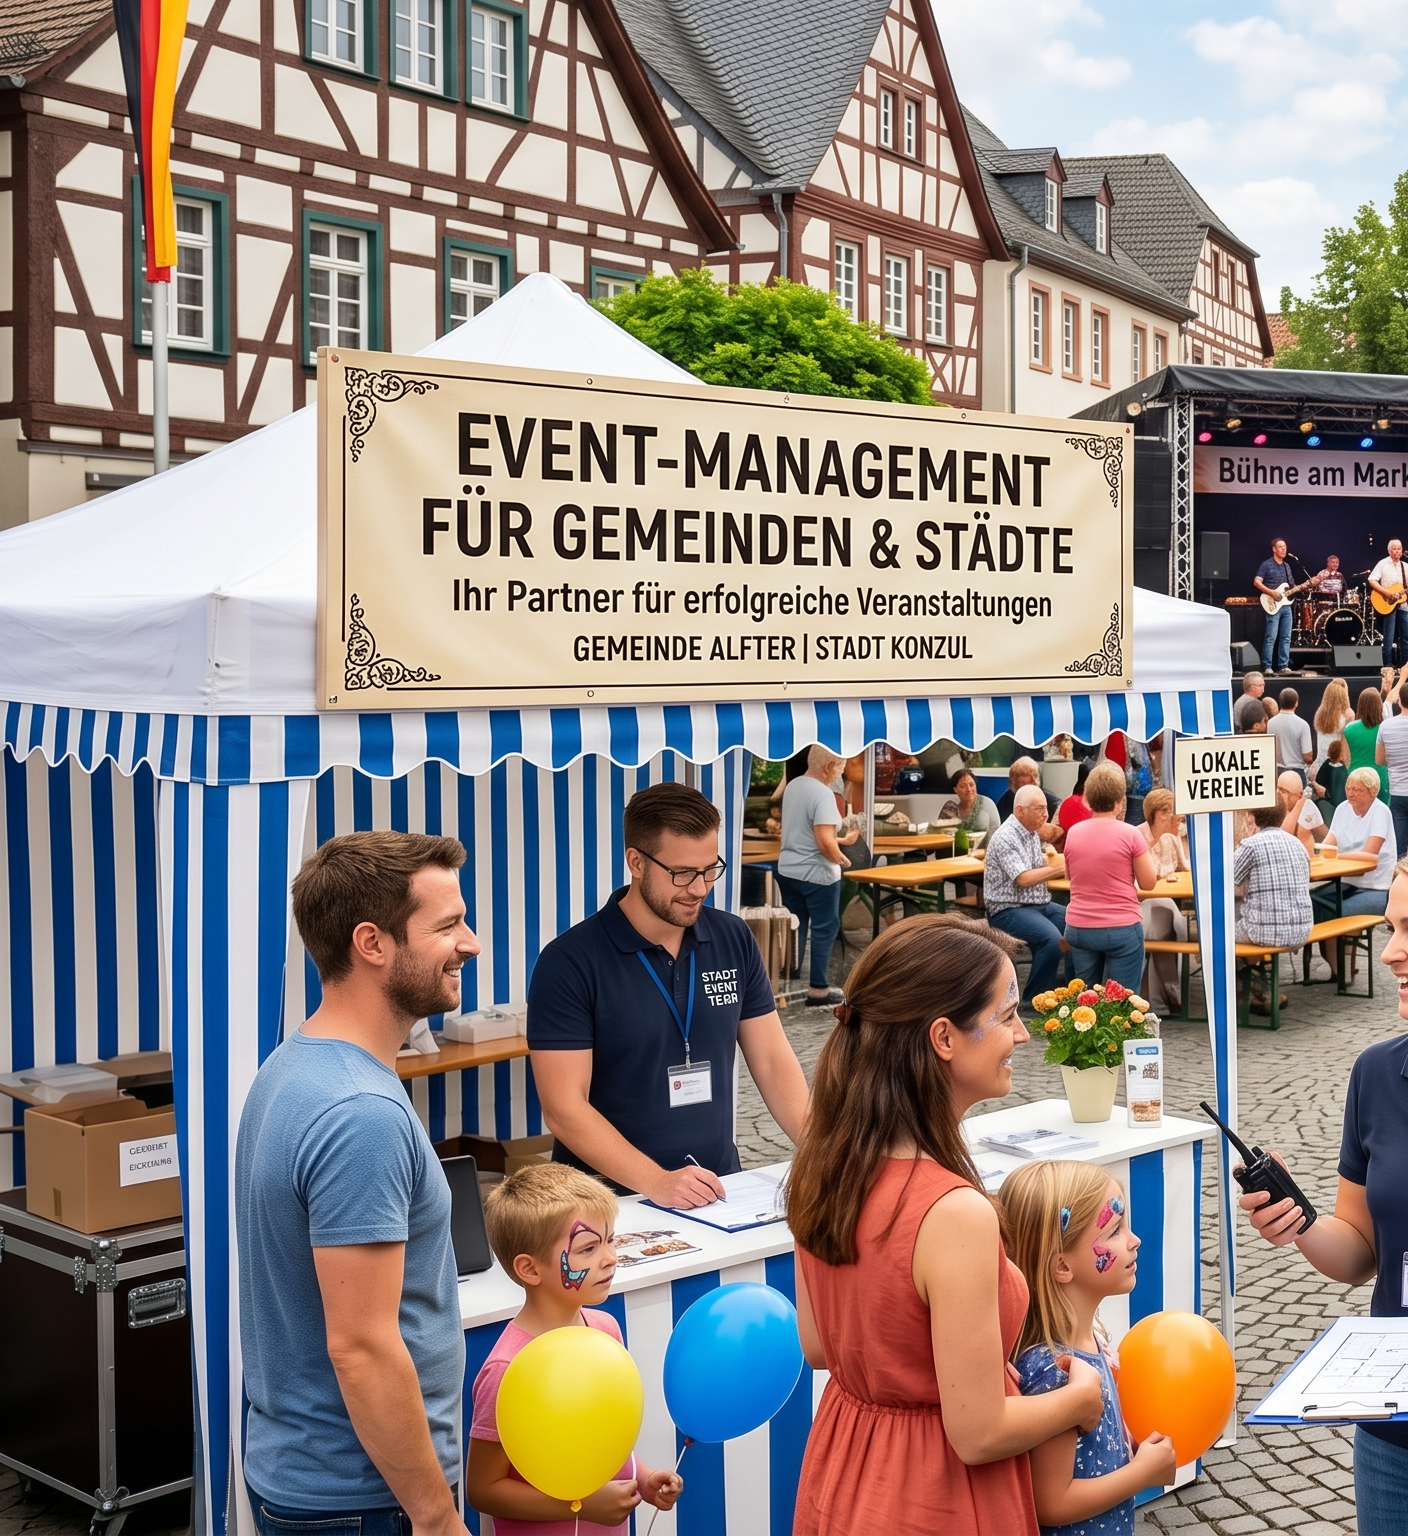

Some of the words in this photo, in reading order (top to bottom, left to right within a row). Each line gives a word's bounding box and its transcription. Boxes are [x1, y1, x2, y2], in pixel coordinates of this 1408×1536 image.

[458, 411, 1051, 508] EVENT-MANAGEMENT
[1218, 456, 1299, 484] Bühne
[1308, 463, 1344, 486] am
[422, 485, 535, 559] FÜR
[553, 503, 852, 568] GEMEINDEN
[869, 518, 902, 569] &
[915, 512, 1074, 574] STÄDTE
[453, 578, 498, 612] Ihr
[507, 580, 625, 613] Partner
[632, 581, 676, 614] für
[684, 582, 850, 623] erfolgreiche
[856, 587, 1052, 624] Veranstaltungen
[573, 635, 703, 662] GEMEINDE
[709, 635, 796, 661] ALFTER
[815, 635, 886, 661] STADT
[891, 635, 973, 660] KONZUL
[1191, 749, 1261, 774] LOKALE
[1187, 774, 1265, 801] VEREINE
[702, 969, 738, 982] STADT
[704, 981, 737, 994] EVENT
